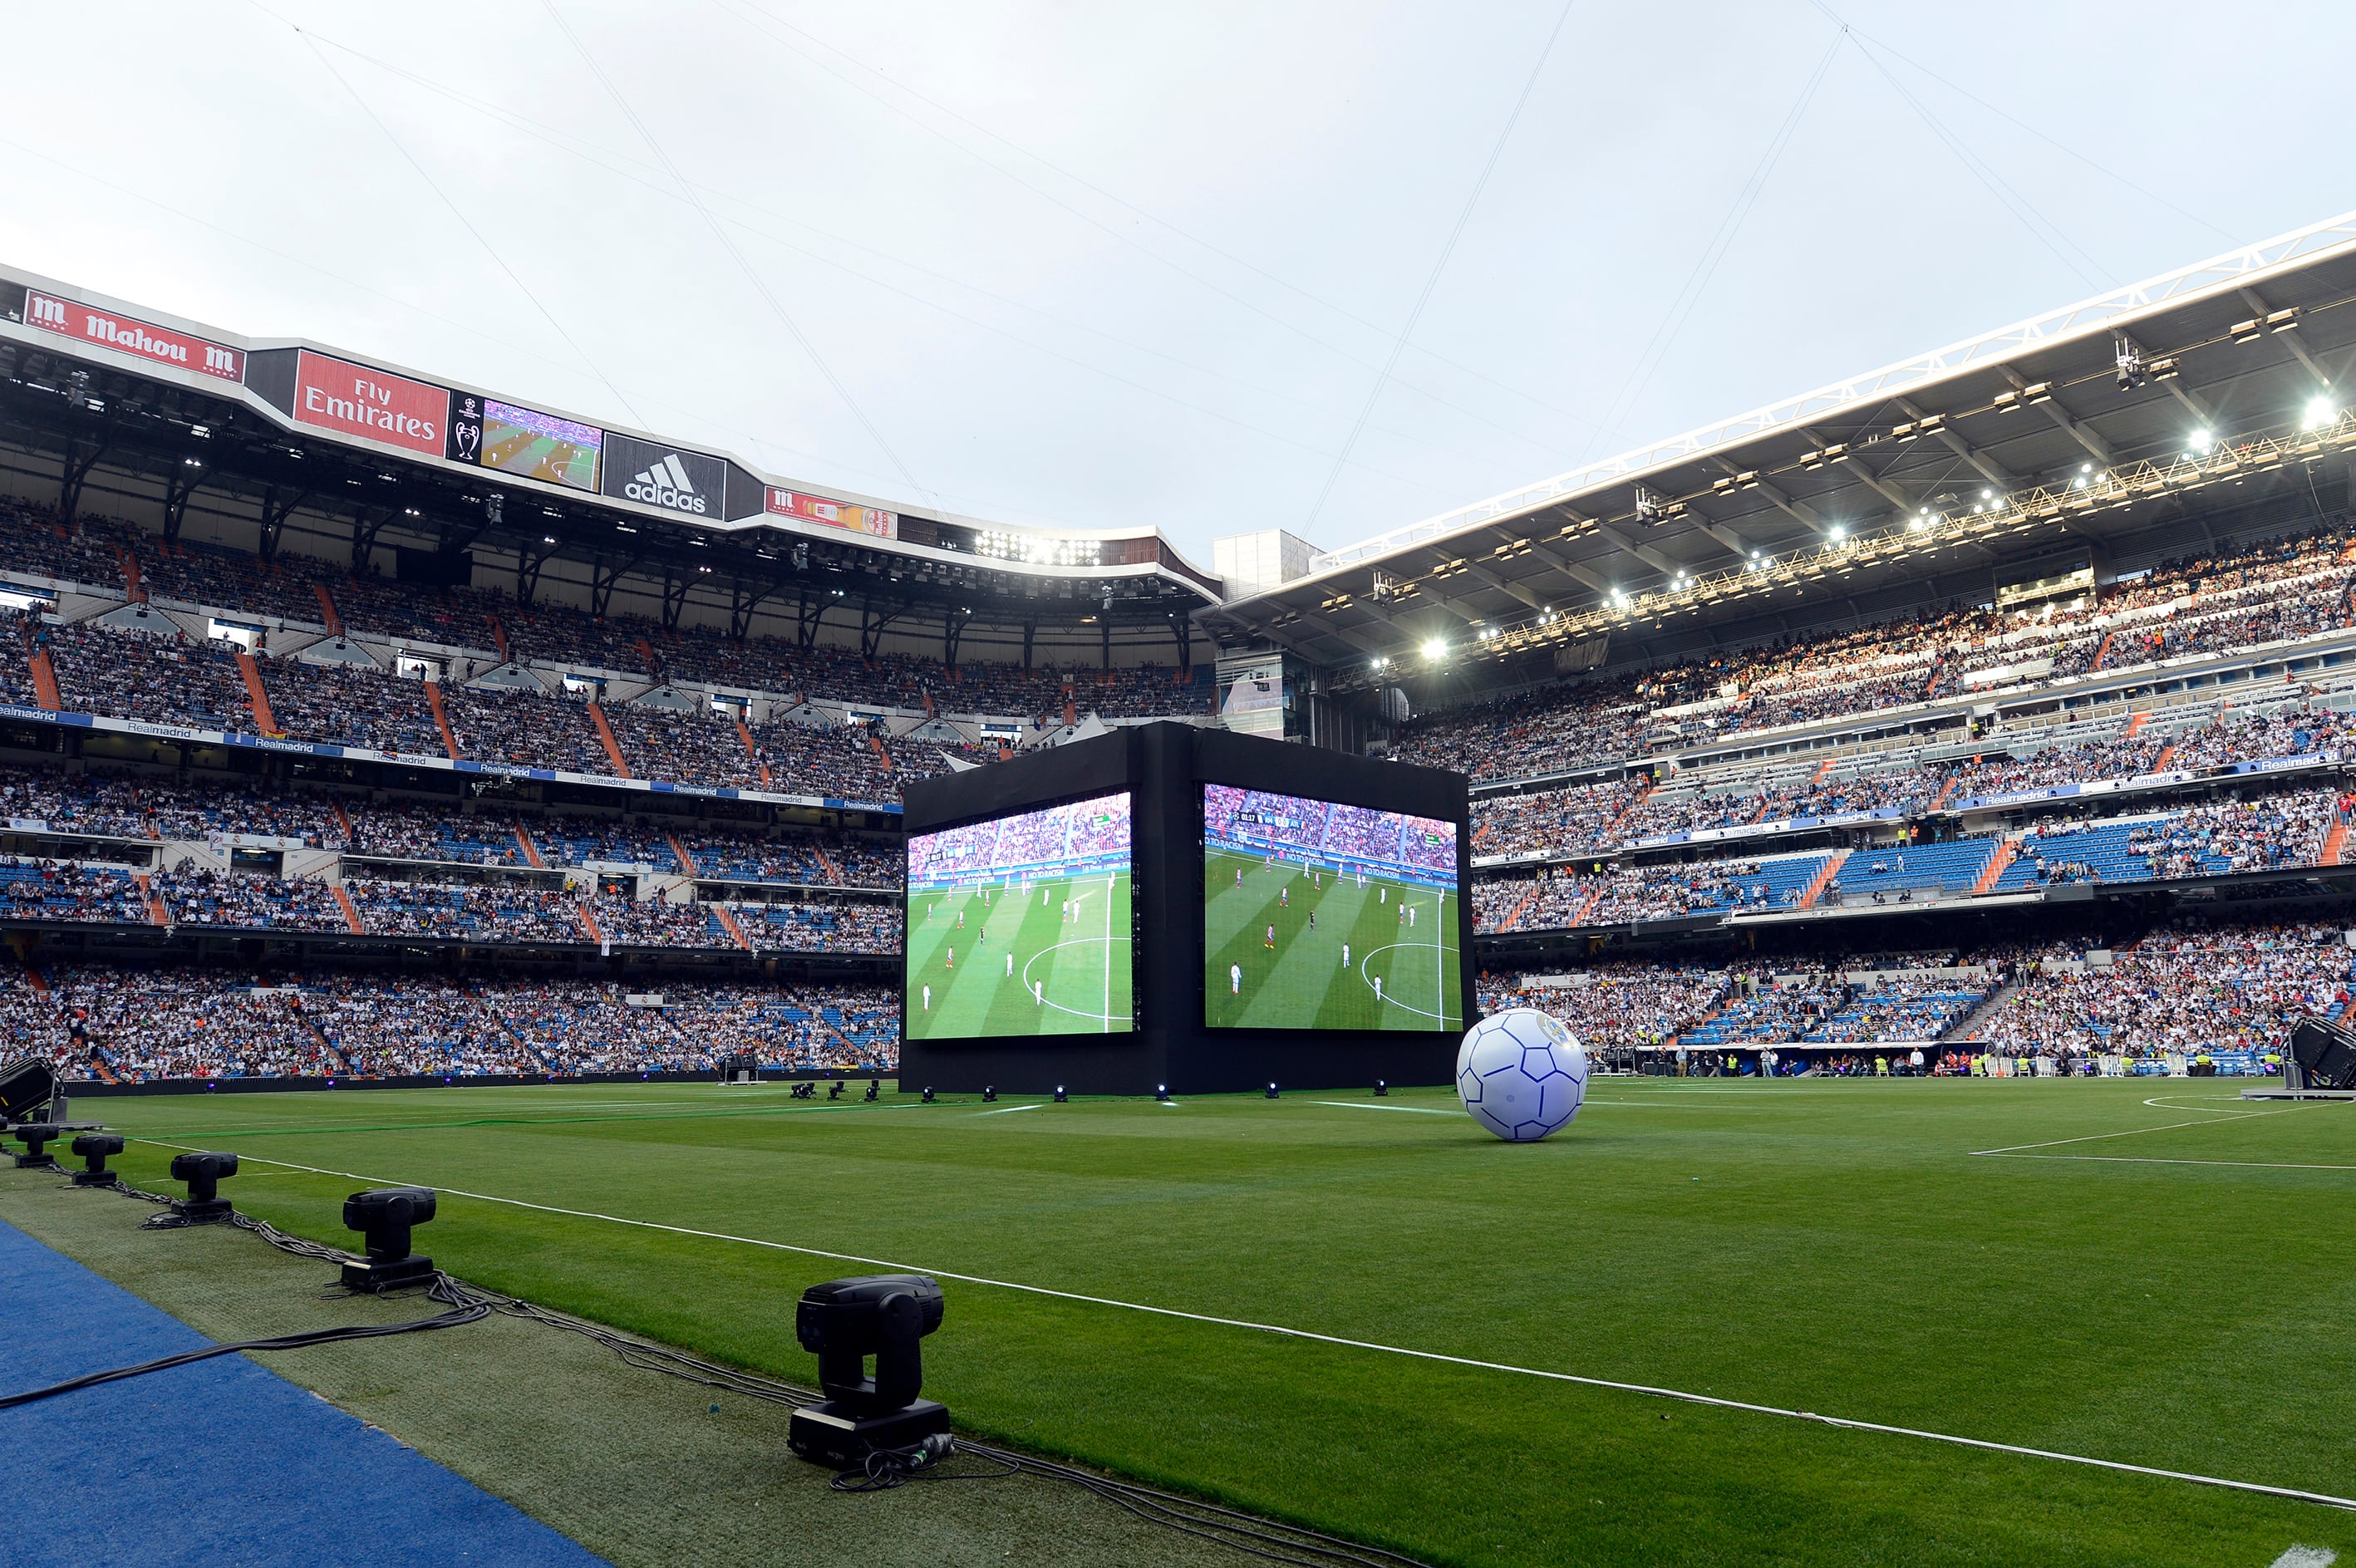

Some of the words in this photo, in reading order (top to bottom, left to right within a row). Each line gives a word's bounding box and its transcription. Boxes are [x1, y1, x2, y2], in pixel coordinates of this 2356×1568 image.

[86, 315, 188, 362] Mahou
[355, 379, 391, 406] Fly
[305, 386, 435, 440] Emirates
[625, 483, 706, 514] adidas
[0, 705, 56, 722] ealmadrid
[128, 722, 191, 738] Realmadrid
[255, 738, 313, 753] Realmadrid
[581, 775, 627, 786] Realmadrid
[674, 784, 717, 796] Realmadrid
[1985, 789, 2048, 805] Realmadrid
[761, 794, 802, 804] Realmadrid
[844, 800, 883, 811] Realmadrid
[1296, 854, 1305, 863] TO
